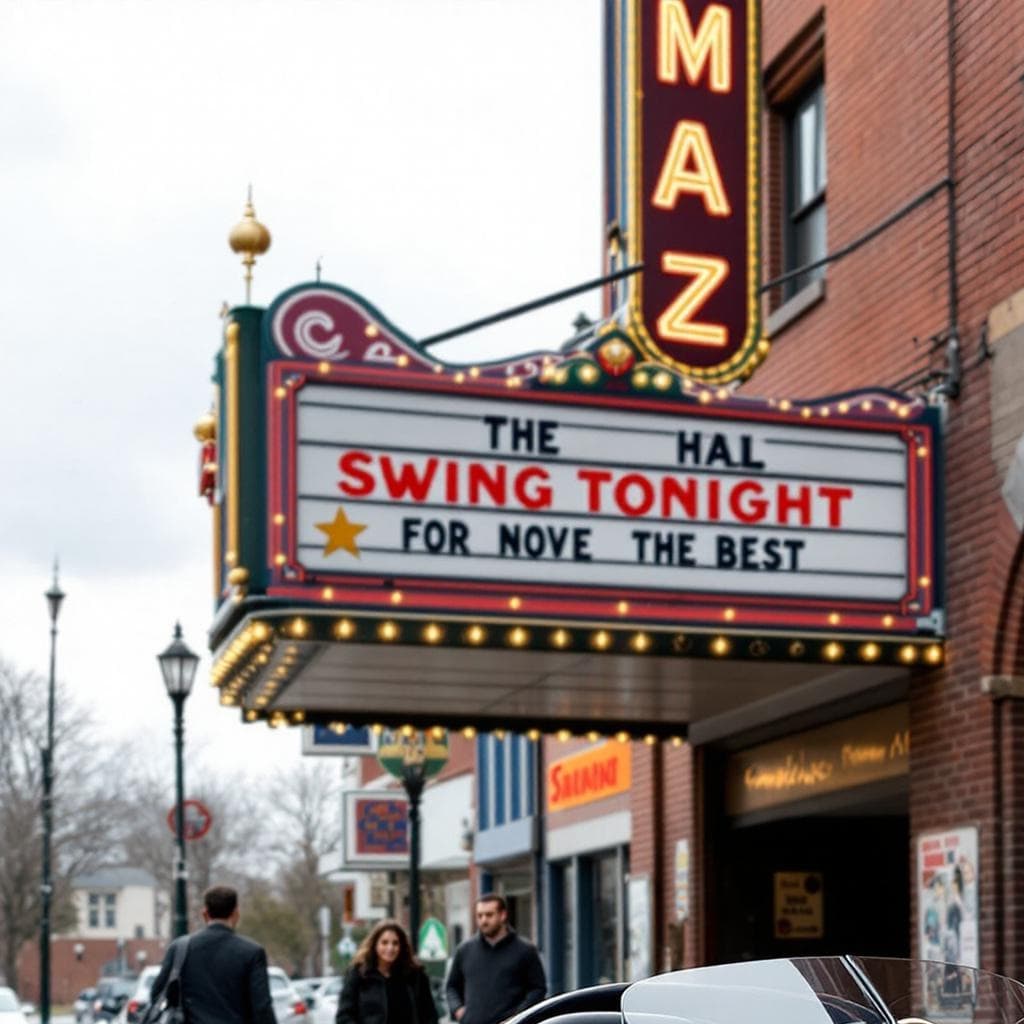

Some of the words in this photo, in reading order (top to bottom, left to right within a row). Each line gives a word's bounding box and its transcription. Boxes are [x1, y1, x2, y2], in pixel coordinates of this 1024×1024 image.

[484, 416, 560, 455] THE
[676, 431, 766, 471] HAL
[337, 450, 554, 511] SWING
[577, 469, 854, 528] TONIGHT
[401, 518, 469, 557] FOR
[499, 525, 593, 562] NOVE
[632, 531, 697, 568] THE
[715, 535, 806, 572] BEST
